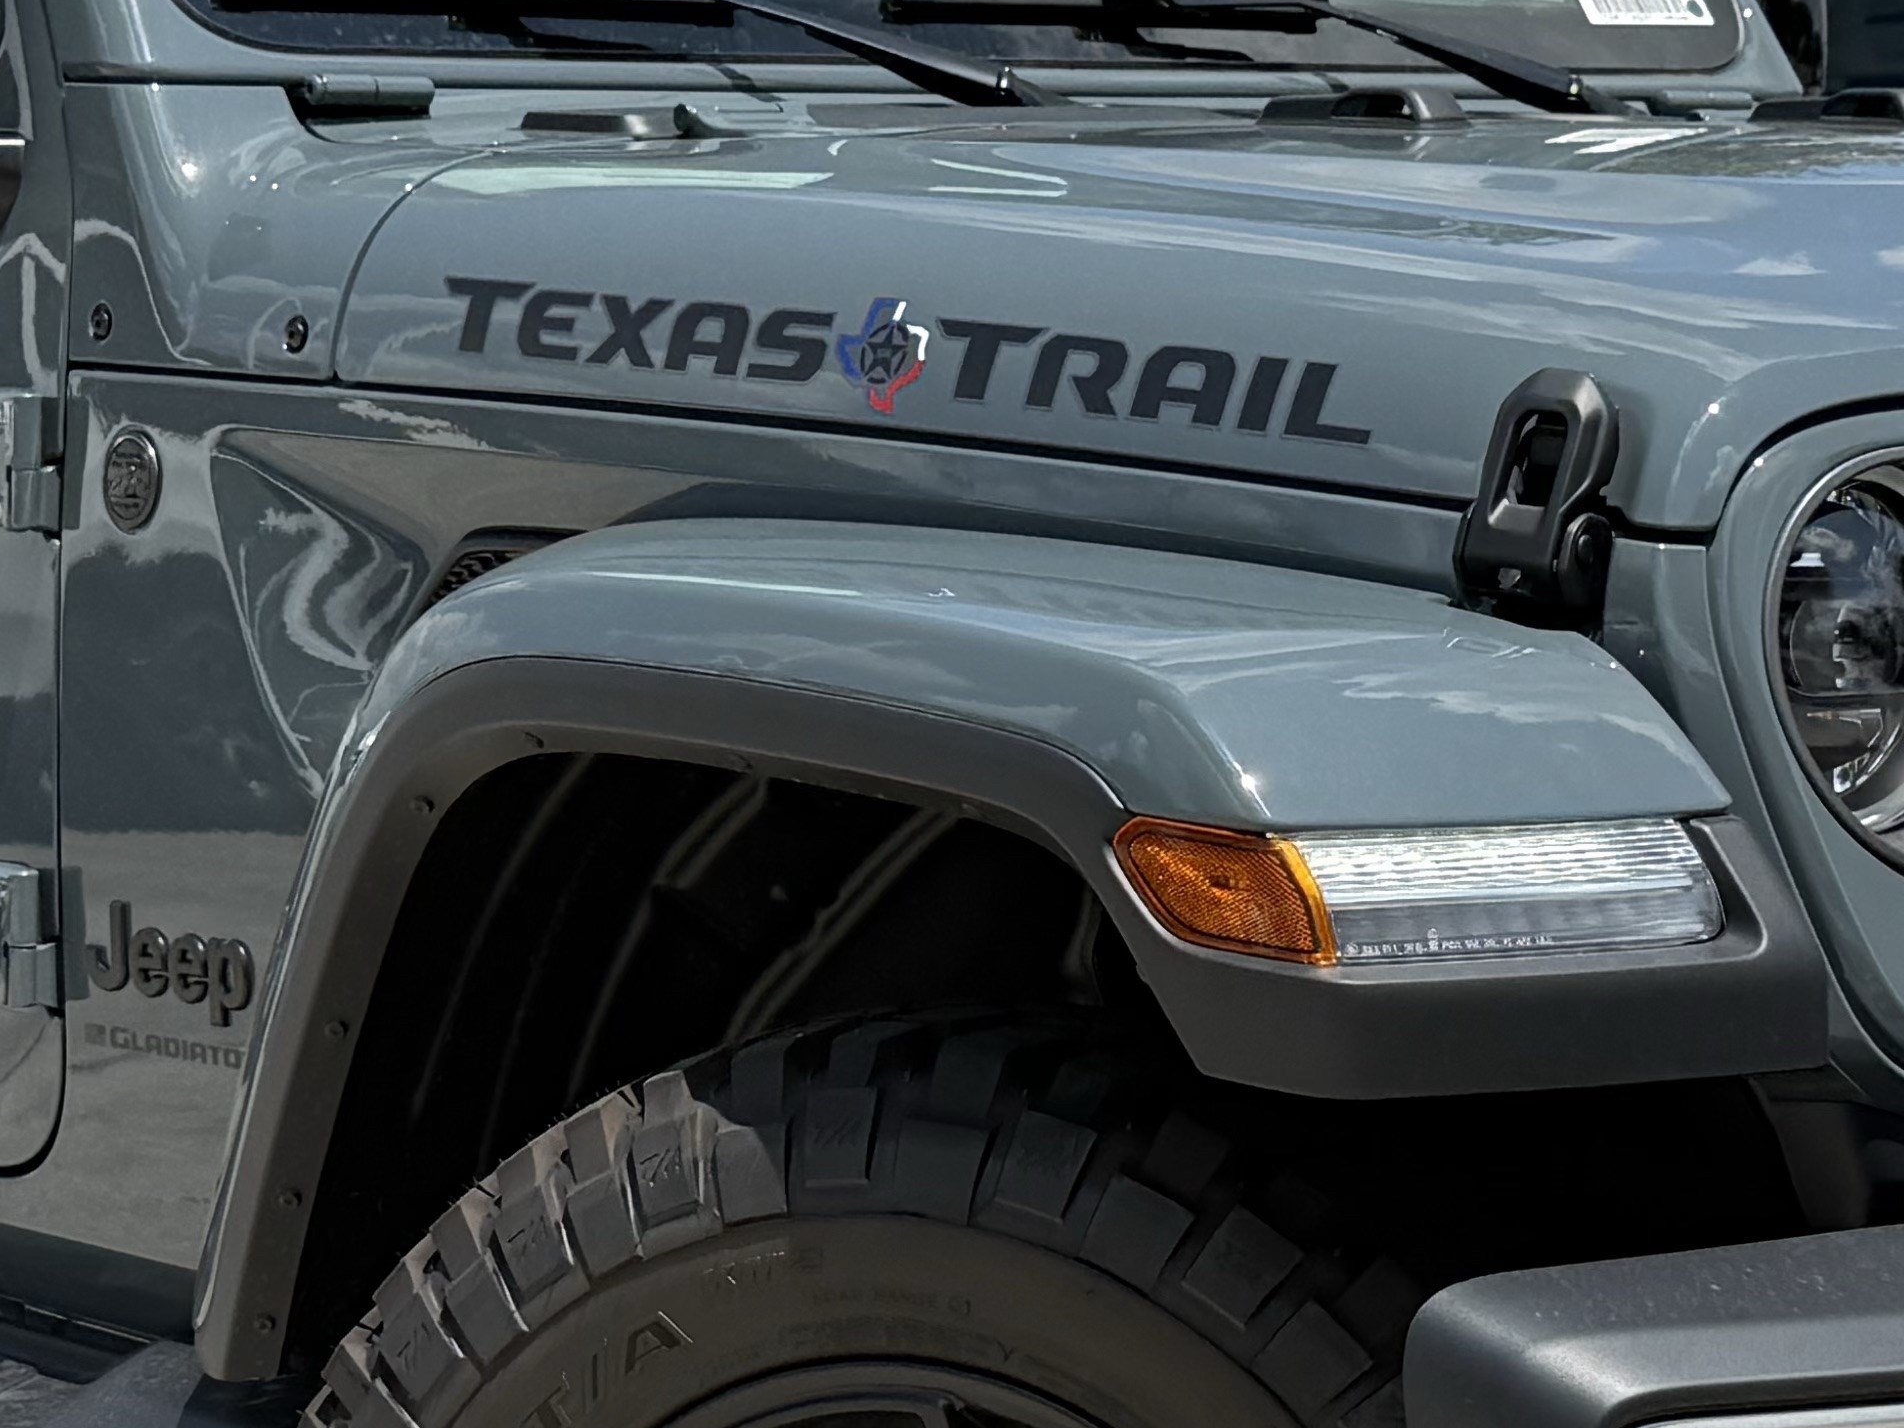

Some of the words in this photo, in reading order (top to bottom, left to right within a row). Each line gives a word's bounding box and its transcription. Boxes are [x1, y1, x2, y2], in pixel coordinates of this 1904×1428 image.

[443, 274, 840, 387] TEXAS
[934, 316, 1373, 448] TRAIL
[85, 898, 256, 1028] Jeep
[108, 1025, 246, 1070] GLADIATO
